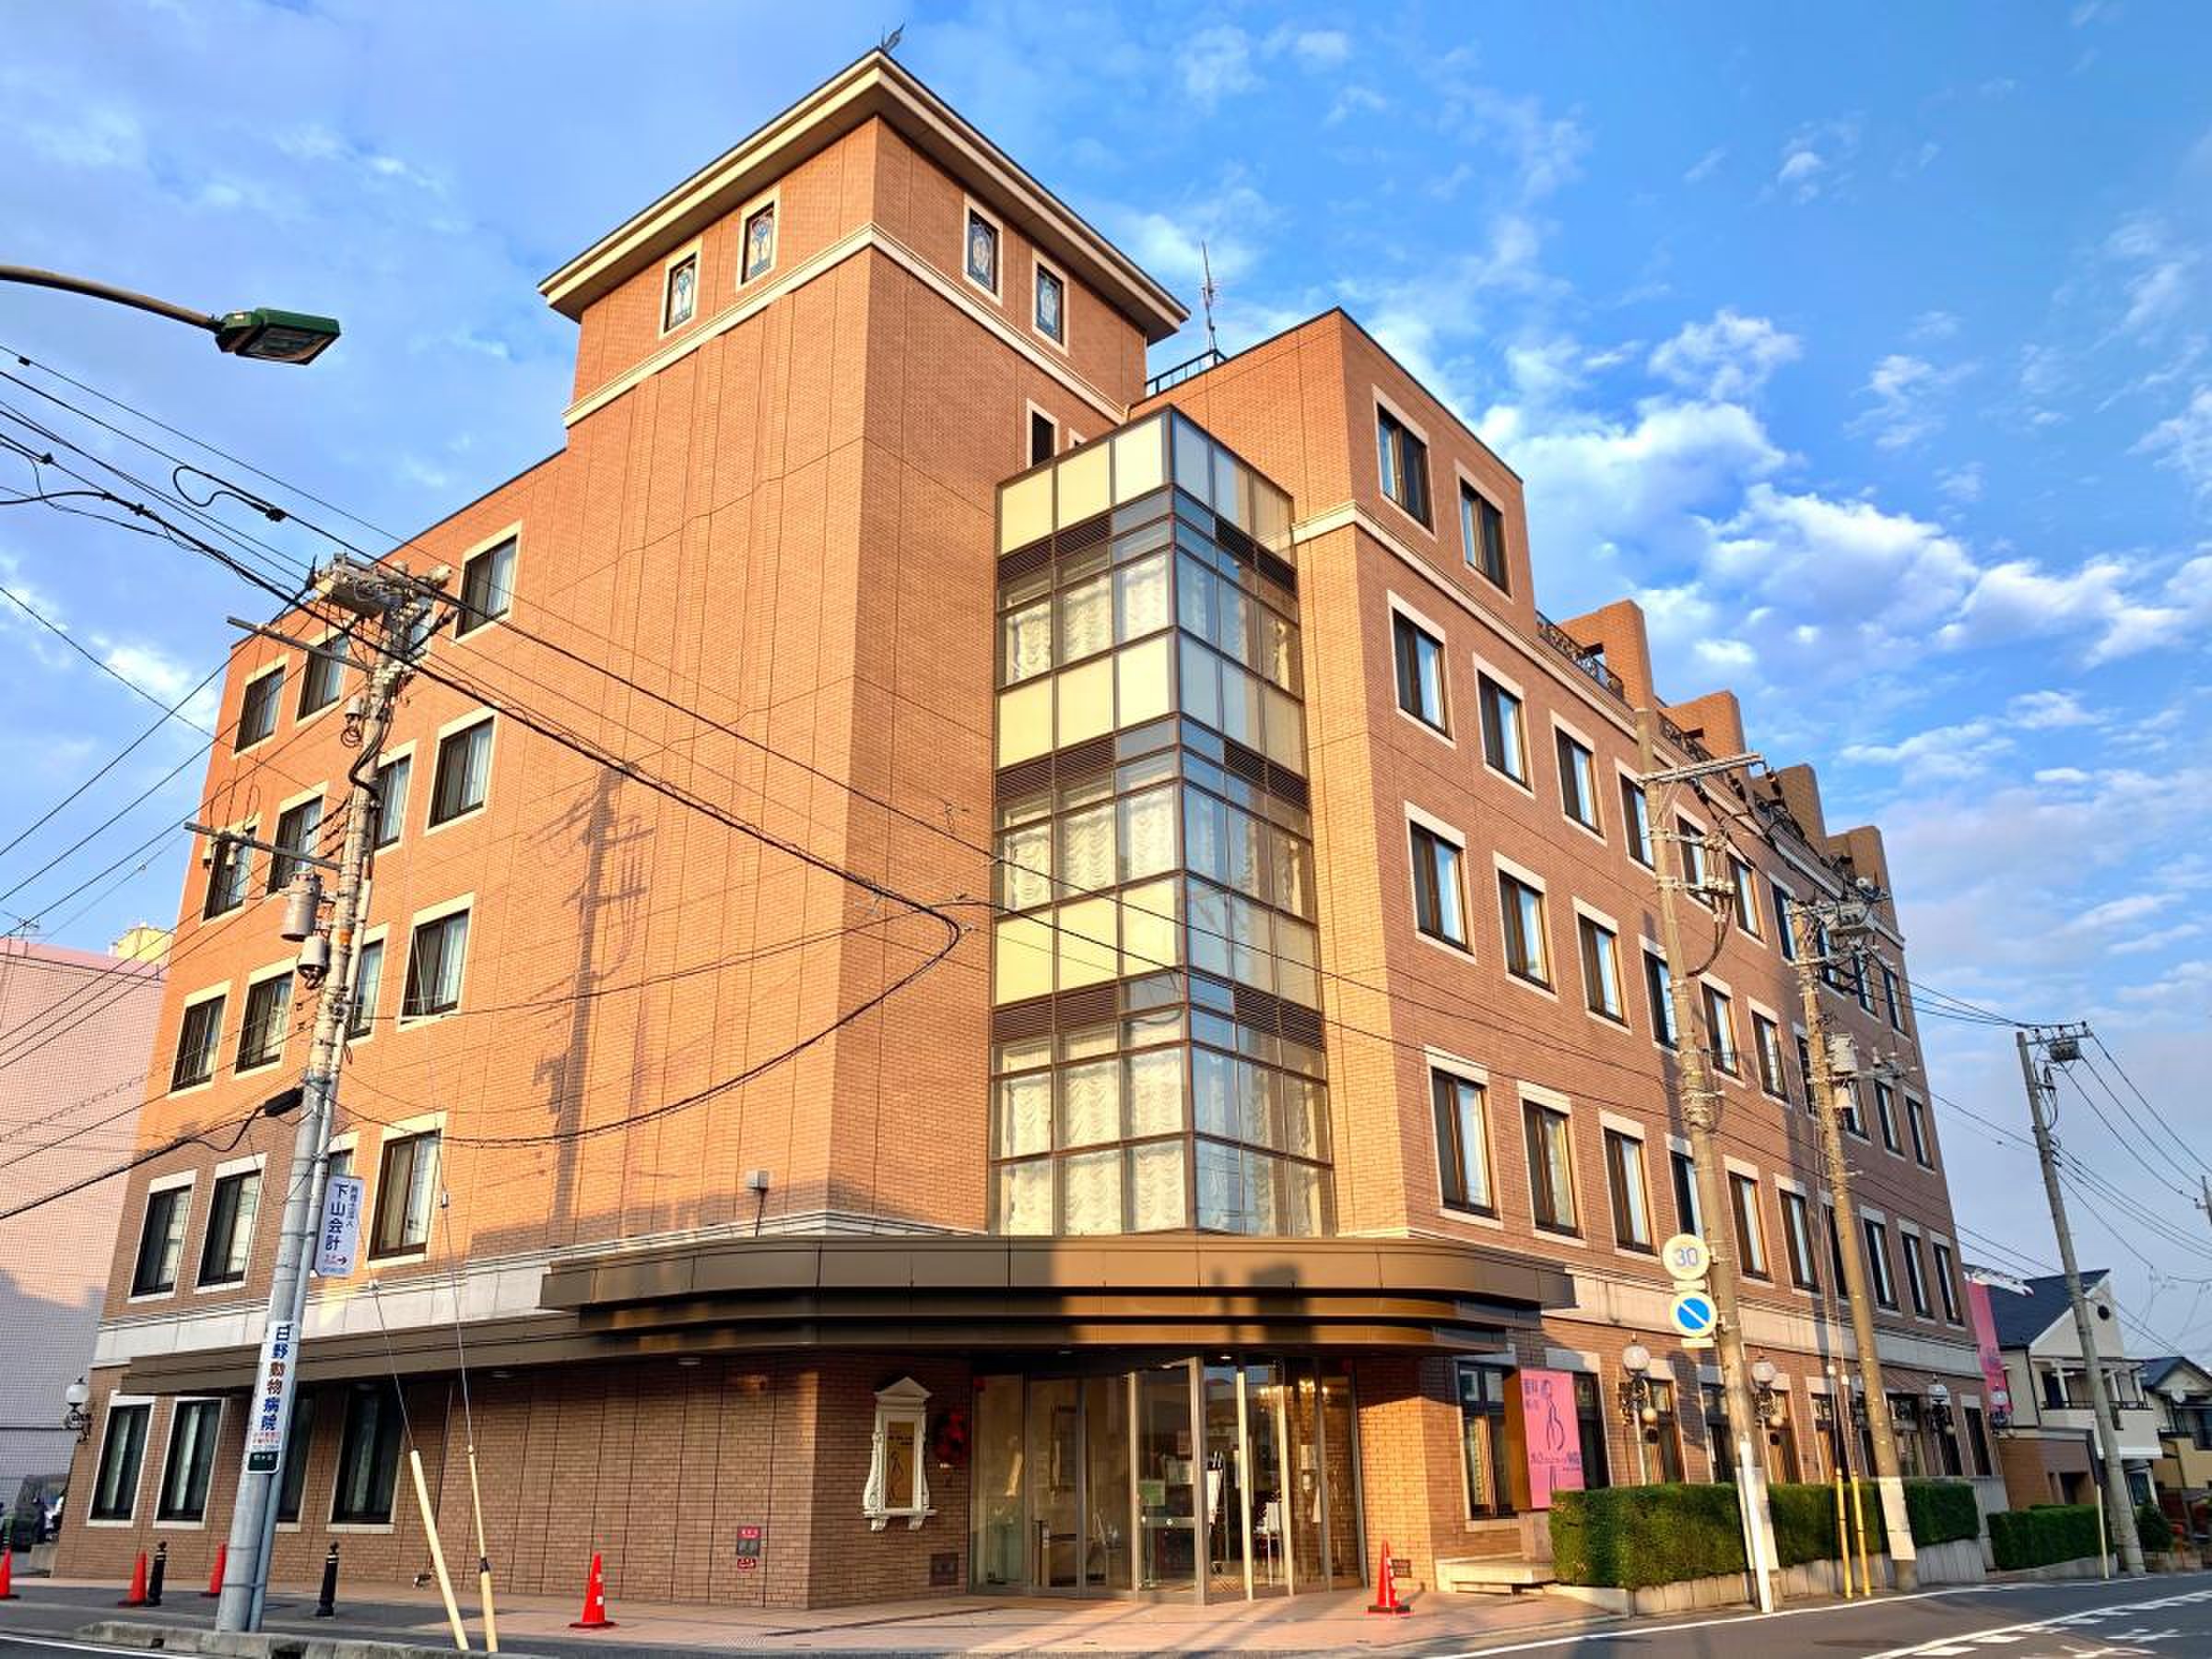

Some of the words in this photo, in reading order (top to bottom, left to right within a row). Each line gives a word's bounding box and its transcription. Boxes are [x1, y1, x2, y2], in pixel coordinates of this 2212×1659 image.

[325, 1183, 348, 1252] 下山会計
[1674, 1247, 1699, 1267] 30
[261, 1325, 290, 1430] 日野動物病院
